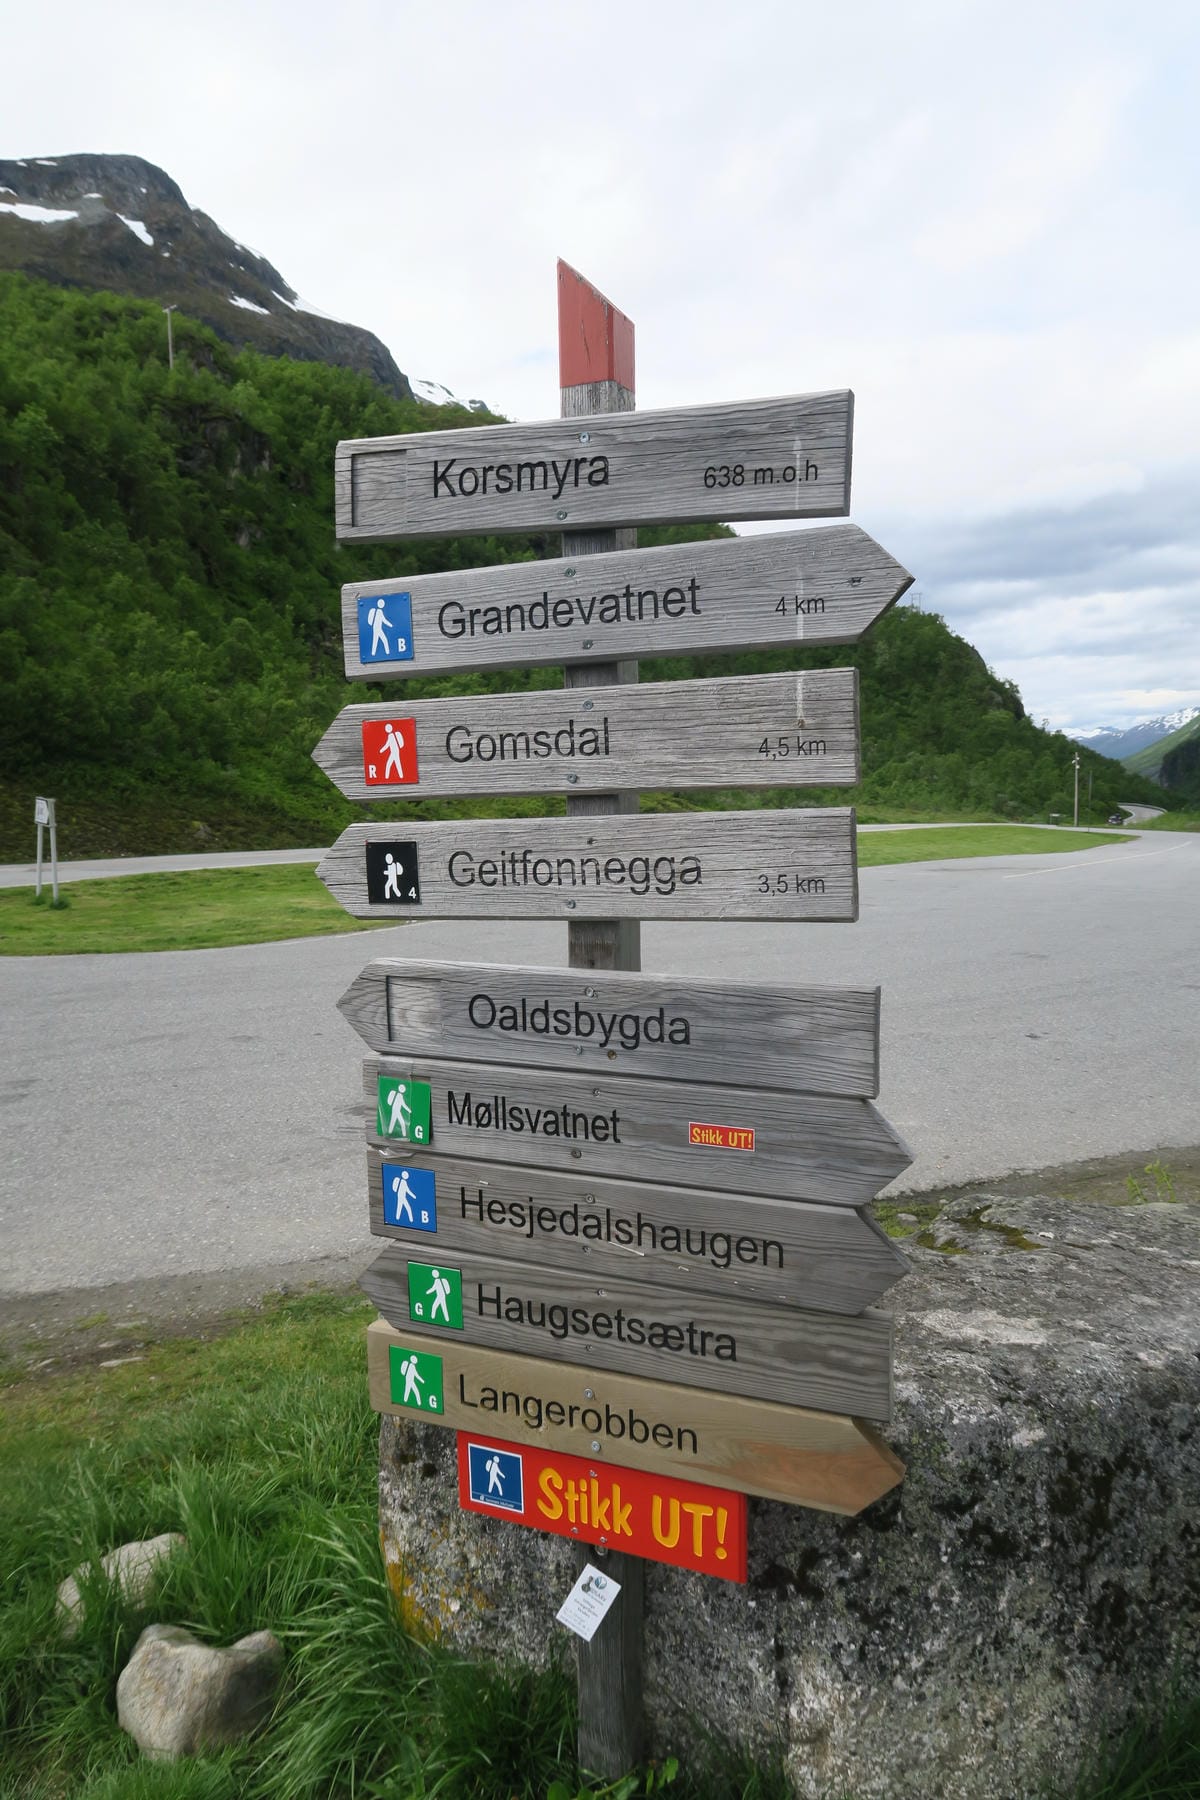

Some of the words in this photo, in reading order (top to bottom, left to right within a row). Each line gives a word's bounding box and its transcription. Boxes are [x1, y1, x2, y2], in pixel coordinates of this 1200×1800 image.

[433, 455, 609, 500] Korsmyra
[703, 464, 745, 489] 638
[753, 459, 819, 484] m.o.h
[438, 578, 702, 638] Grandevatnet
[775, 597, 787, 616] 4
[795, 595, 825, 615] km
[397, 637, 407, 653] B
[446, 716, 610, 763] Gomsdal
[758, 737, 790, 760] 4,5
[796, 735, 827, 756] km
[368, 764, 378, 779] R
[408, 886, 417, 899] 4
[448, 850, 703, 895] Geitfonnegga
[758, 874, 789, 897] 3,5
[795, 873, 825, 894] km
[468, 993, 691, 1050] Oaldsbygda
[414, 1125, 424, 1140] G
[447, 1090, 622, 1144] Møllsvatnet
[691, 1127, 723, 1145] Stikk
[728, 1131, 753, 1149] UT!
[421, 1210, 430, 1224] B
[460, 1186, 785, 1268] Hesjedalshaugen
[414, 1302, 424, 1317] G
[477, 1283, 737, 1362] Haugsetsætra
[428, 1395, 437, 1409] G
[459, 1374, 698, 1454] Langerobben
[536, 1467, 633, 1537] Stikk
[652, 1494, 728, 1561] UT!
